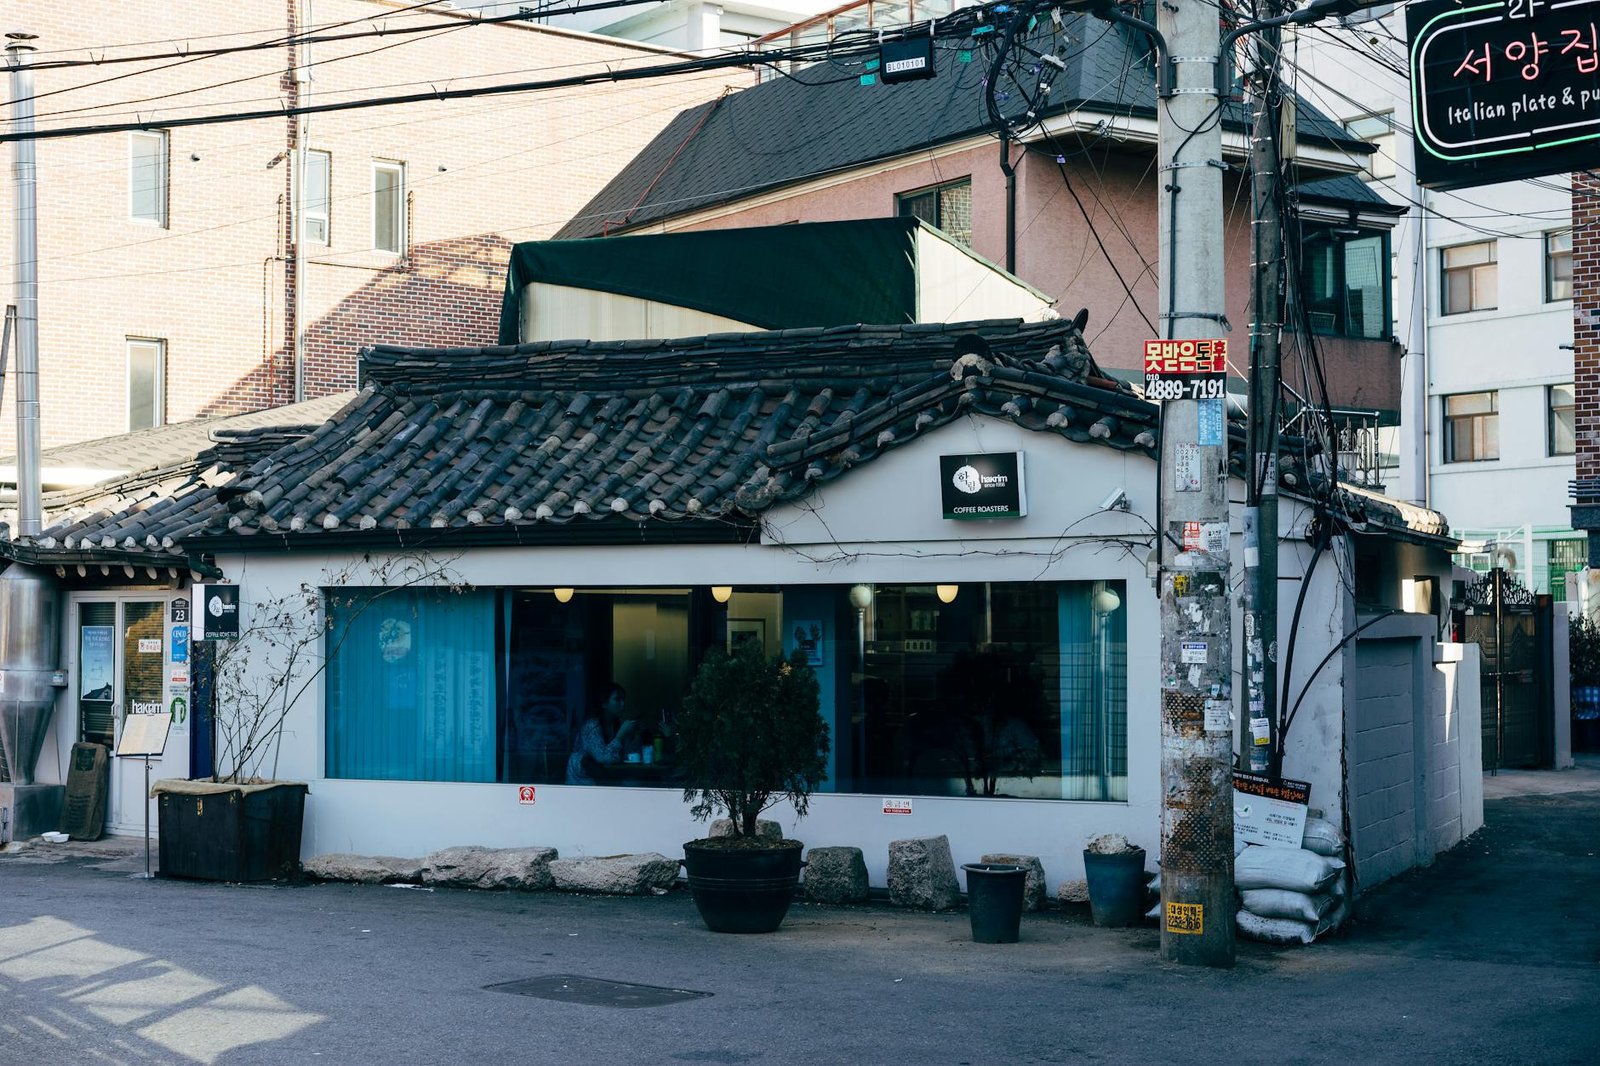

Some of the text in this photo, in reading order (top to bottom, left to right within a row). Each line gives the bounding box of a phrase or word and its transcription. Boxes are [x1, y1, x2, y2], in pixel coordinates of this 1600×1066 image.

[1453, 22, 1599, 81] 서양집
[1448, 101, 1505, 125] Italian
[1512, 93, 1556, 121] plate
[1562, 87, 1575, 105] &
[1145, 342, 1211, 372] 못받은돈
[1145, 379, 1225, 399] 4889-7191
[953, 505, 1009, 514] COFFEE ROASTERS
[175, 610, 185, 621] 23
